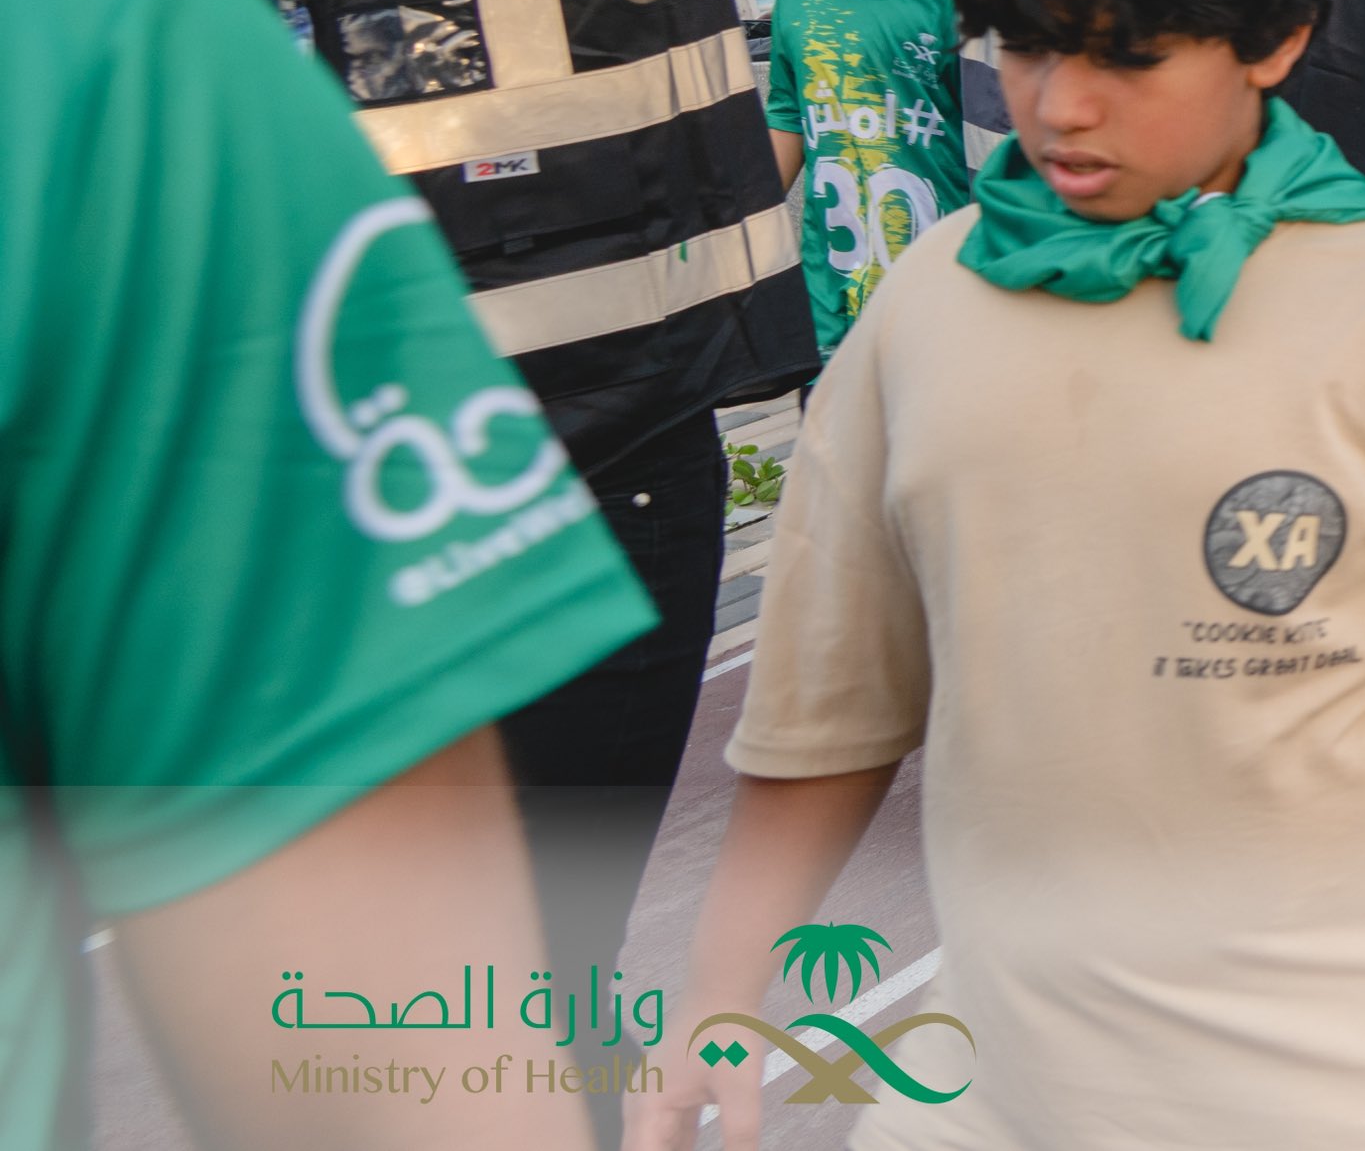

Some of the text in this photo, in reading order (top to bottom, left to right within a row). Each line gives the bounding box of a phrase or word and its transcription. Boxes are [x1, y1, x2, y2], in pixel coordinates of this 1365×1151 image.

[475, 157, 529, 177] 2MK
[813, 156, 945, 279] 30
[1227, 509, 1321, 571] XA
